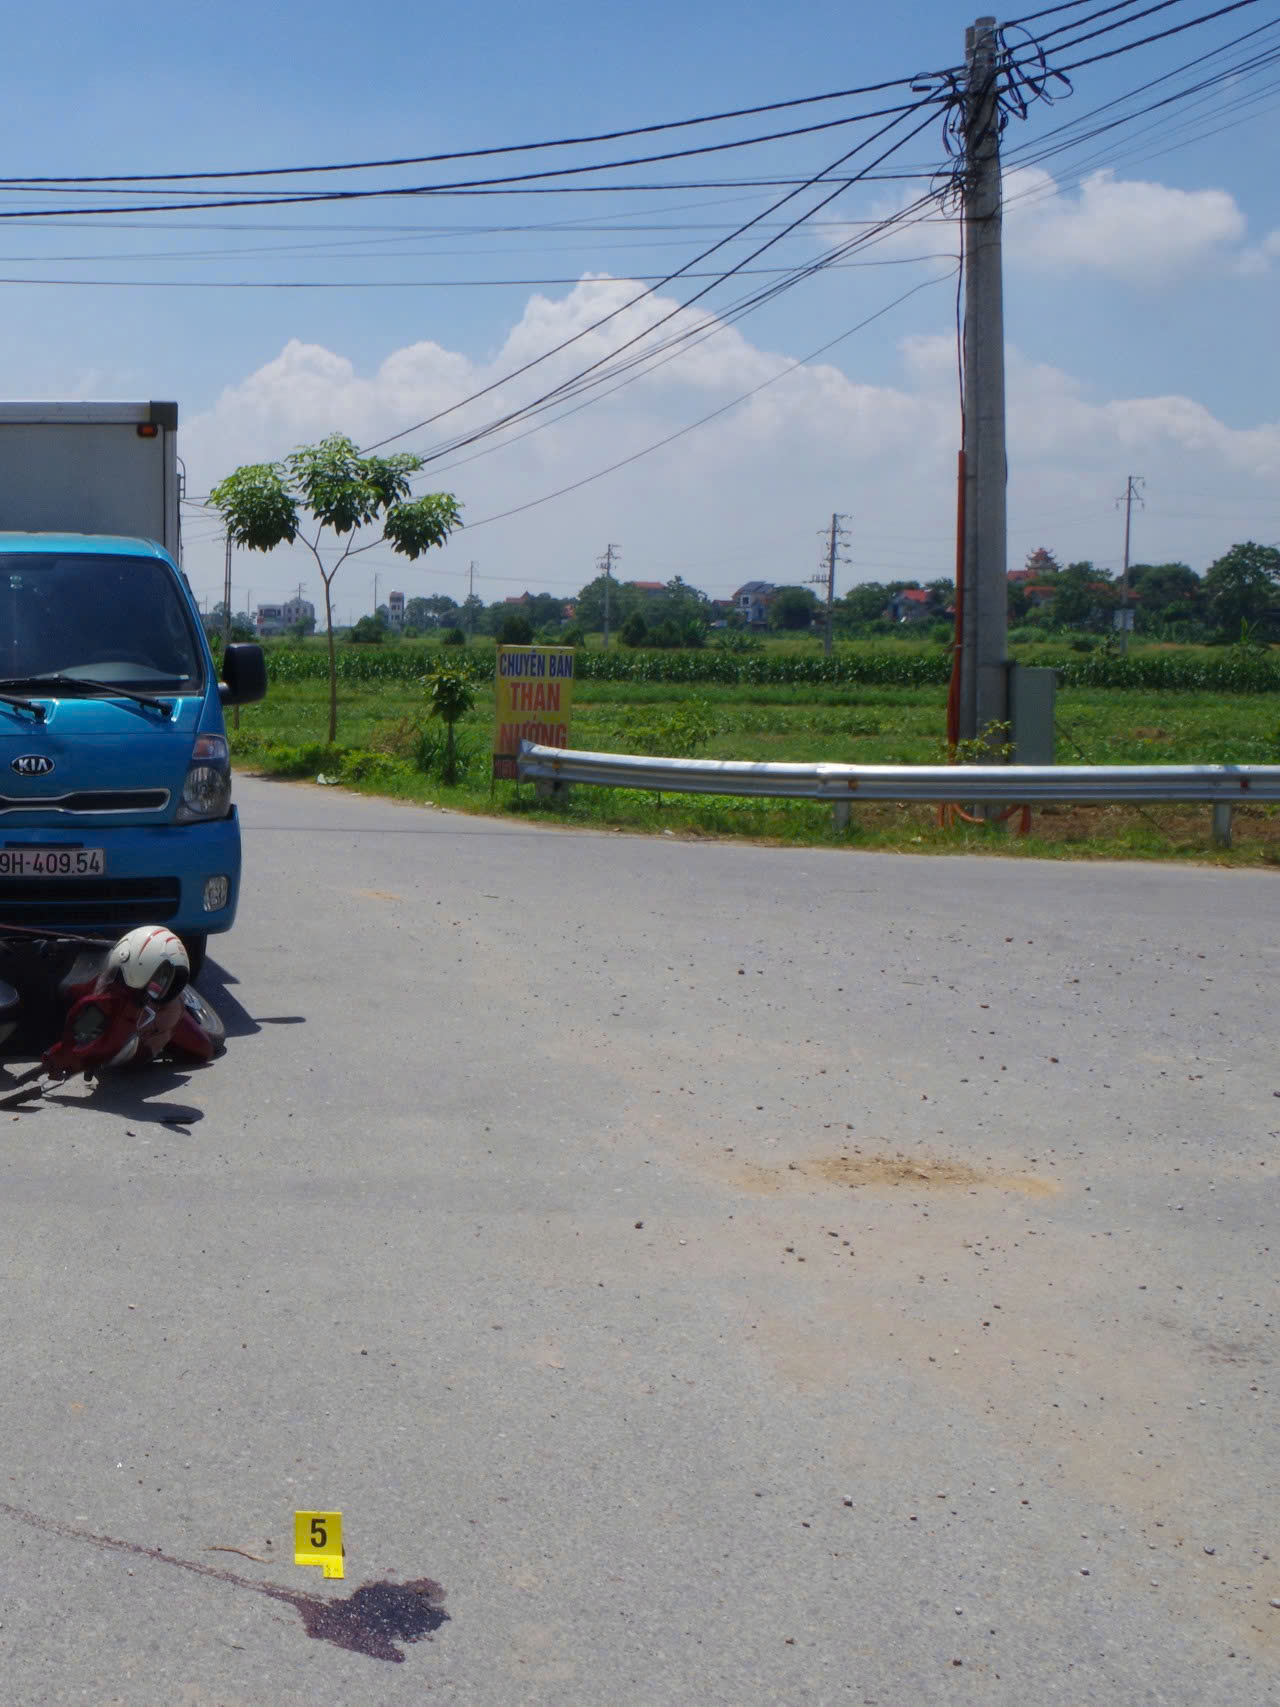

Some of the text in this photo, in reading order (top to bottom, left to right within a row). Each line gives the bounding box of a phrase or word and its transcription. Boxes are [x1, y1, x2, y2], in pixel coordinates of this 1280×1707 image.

[499, 648, 546, 677] CHUYÊN
[510, 682, 561, 712] THAN
[18, 757, 49, 772] KIA
[311, 1518, 327, 1548] 5
